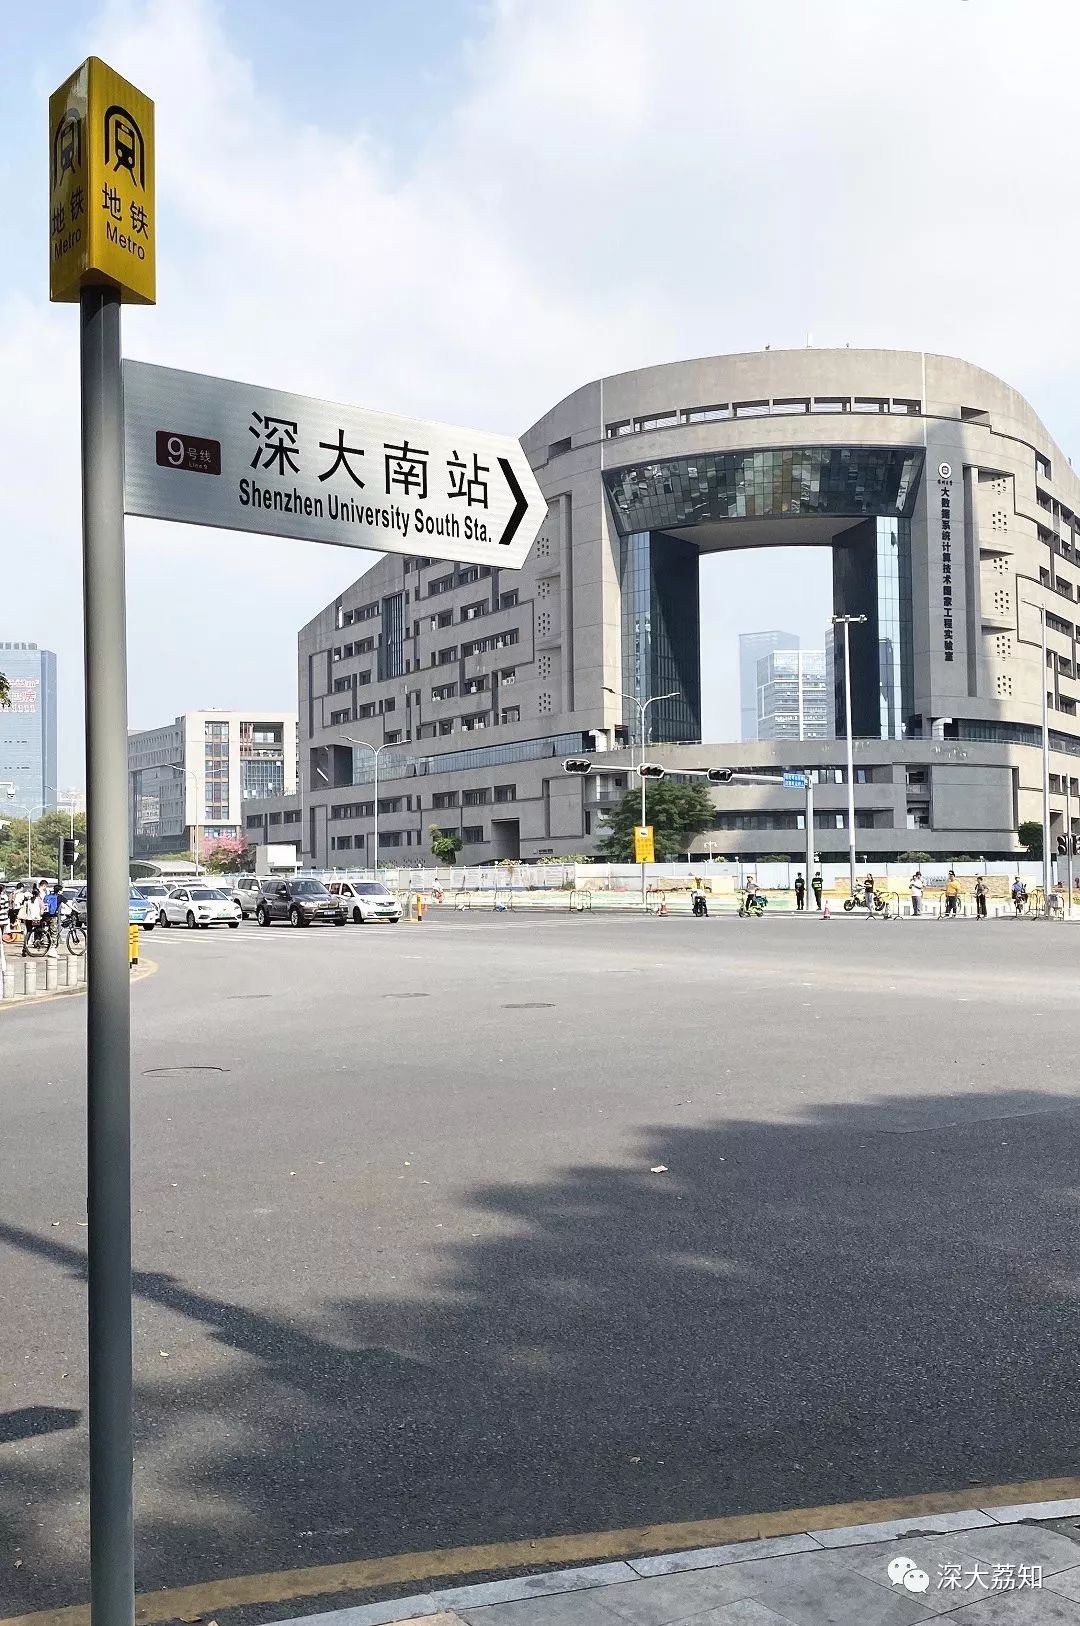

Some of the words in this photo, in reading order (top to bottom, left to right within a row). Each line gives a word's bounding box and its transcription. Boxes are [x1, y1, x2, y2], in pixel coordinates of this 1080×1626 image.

[52, 185, 85, 236] 地铁
[102, 182, 149, 240] 地铁
[54, 229, 82, 259] Metro
[106, 221, 146, 260] Metro
[167, 437, 212, 465] 9号线
[188, 461, 203, 469] Line
[249, 411, 490, 509] 深大南站
[239, 478, 323, 518] Shenzhen
[328, 493, 410, 537] University
[414, 508, 460, 538] South
[464, 515, 492, 543] Sta.
